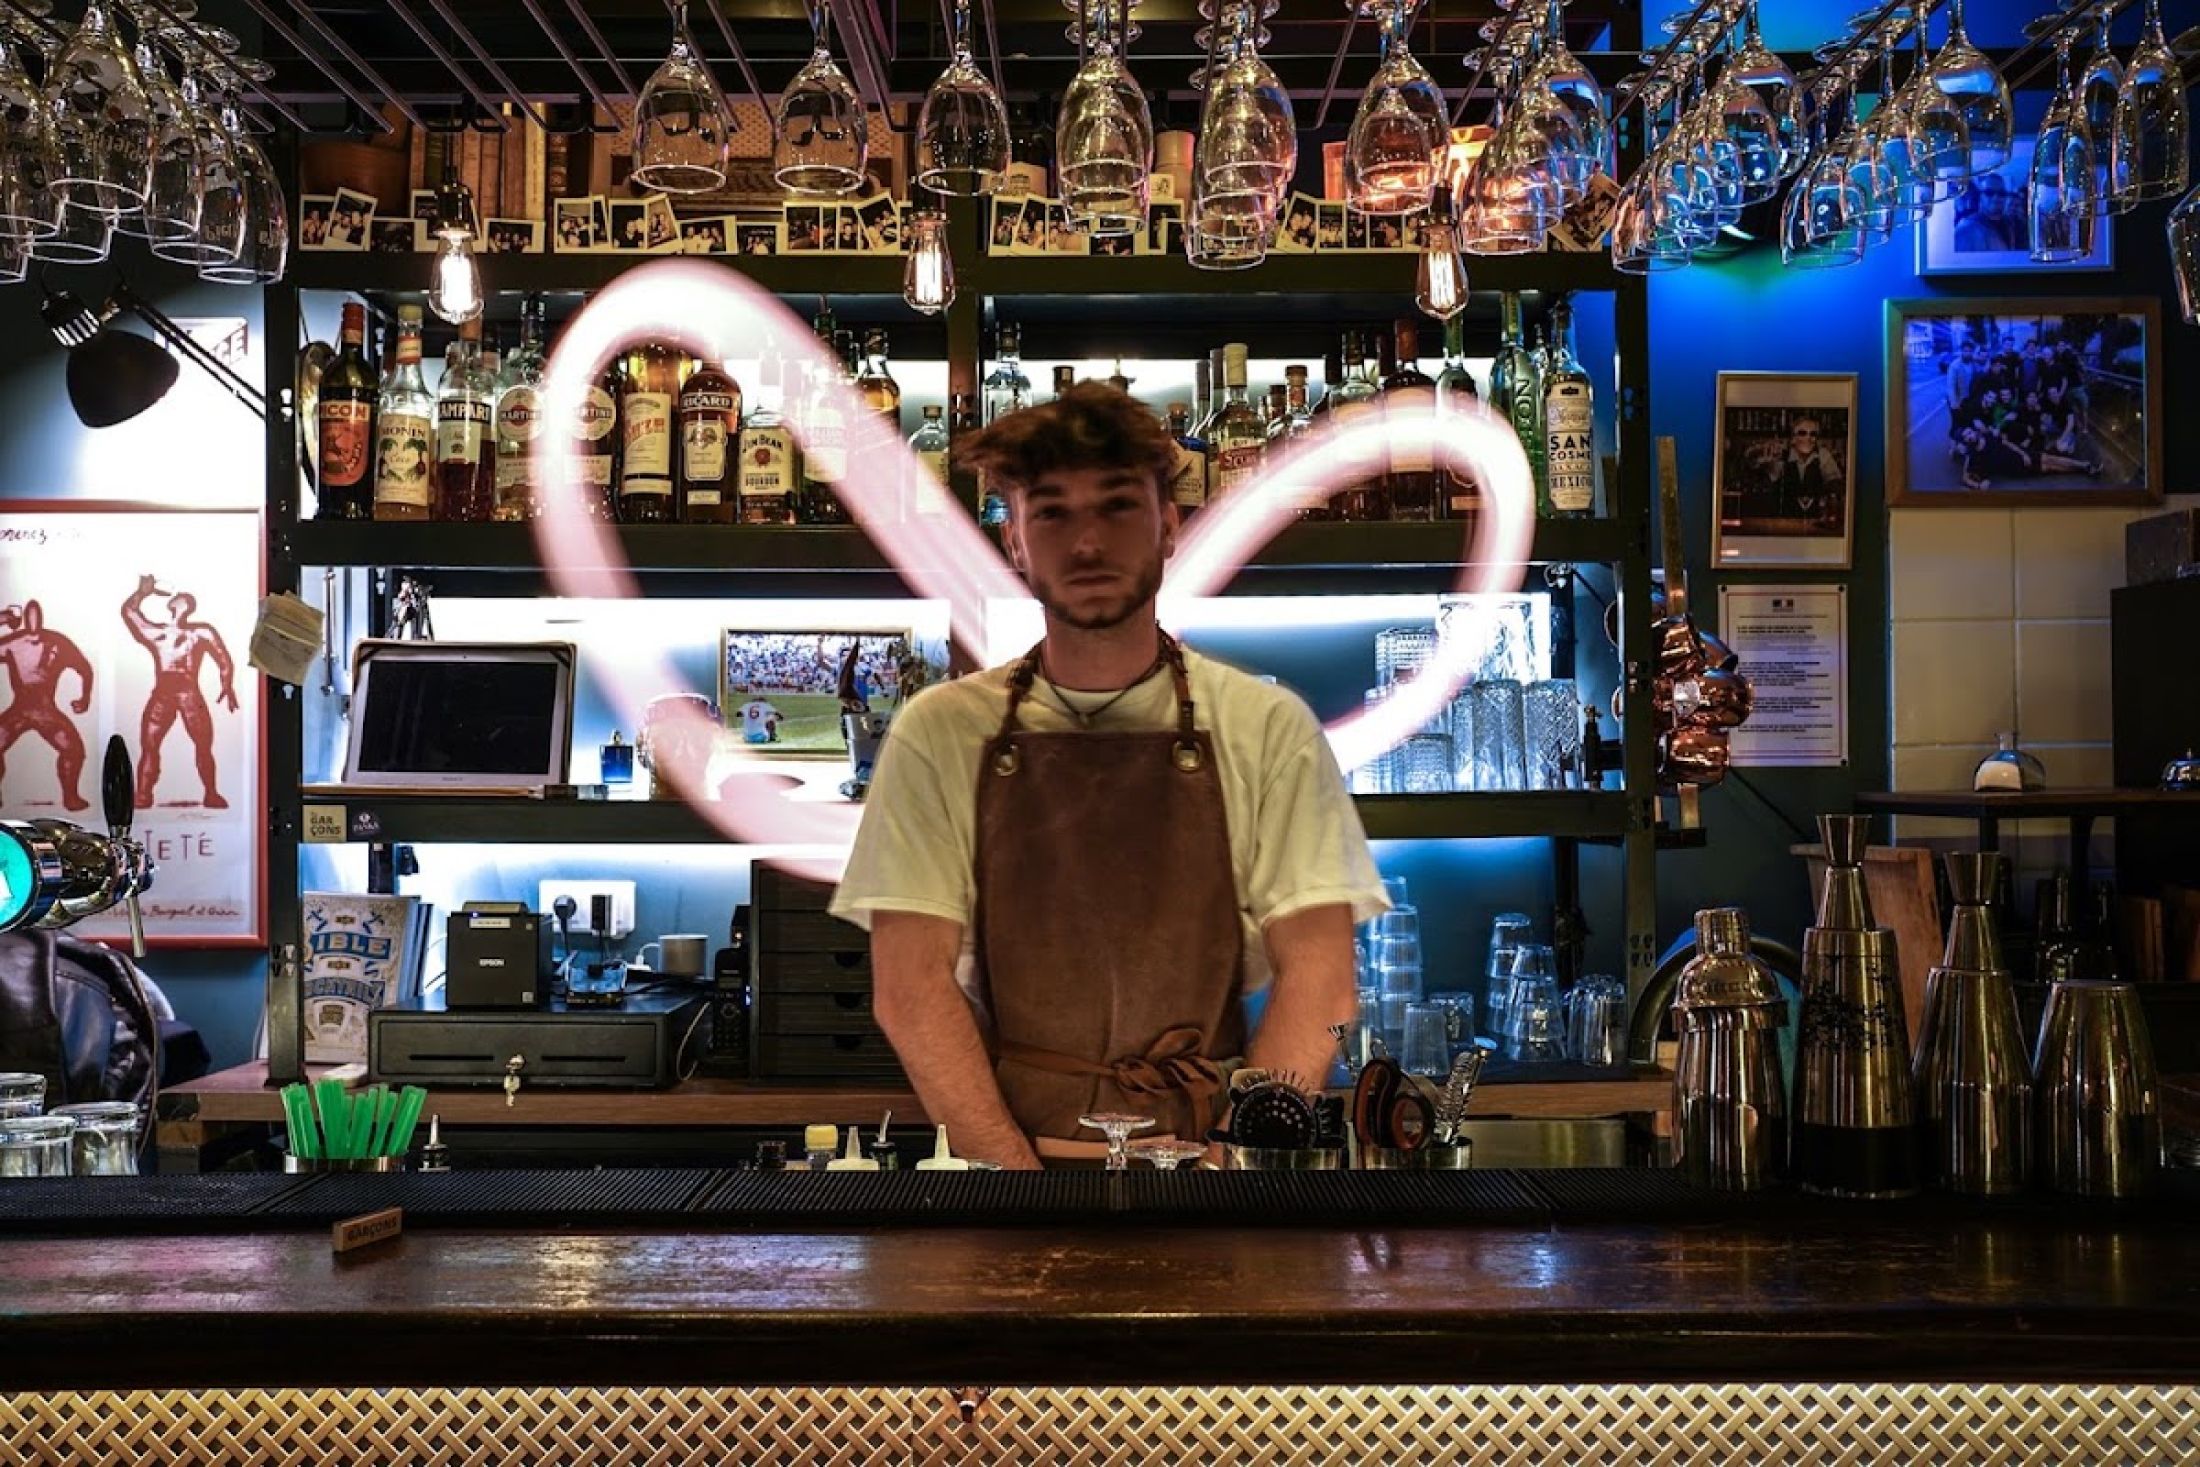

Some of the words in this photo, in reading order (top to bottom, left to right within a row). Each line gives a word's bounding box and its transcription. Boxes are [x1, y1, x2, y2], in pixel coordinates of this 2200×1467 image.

[319, 404, 366, 418] ICON
[440, 402, 489, 420] AMPARI
[1550, 434, 1591, 450] SAN
[317, 934, 388, 957] IBLE
[480, 958, 504, 967] EPSON
